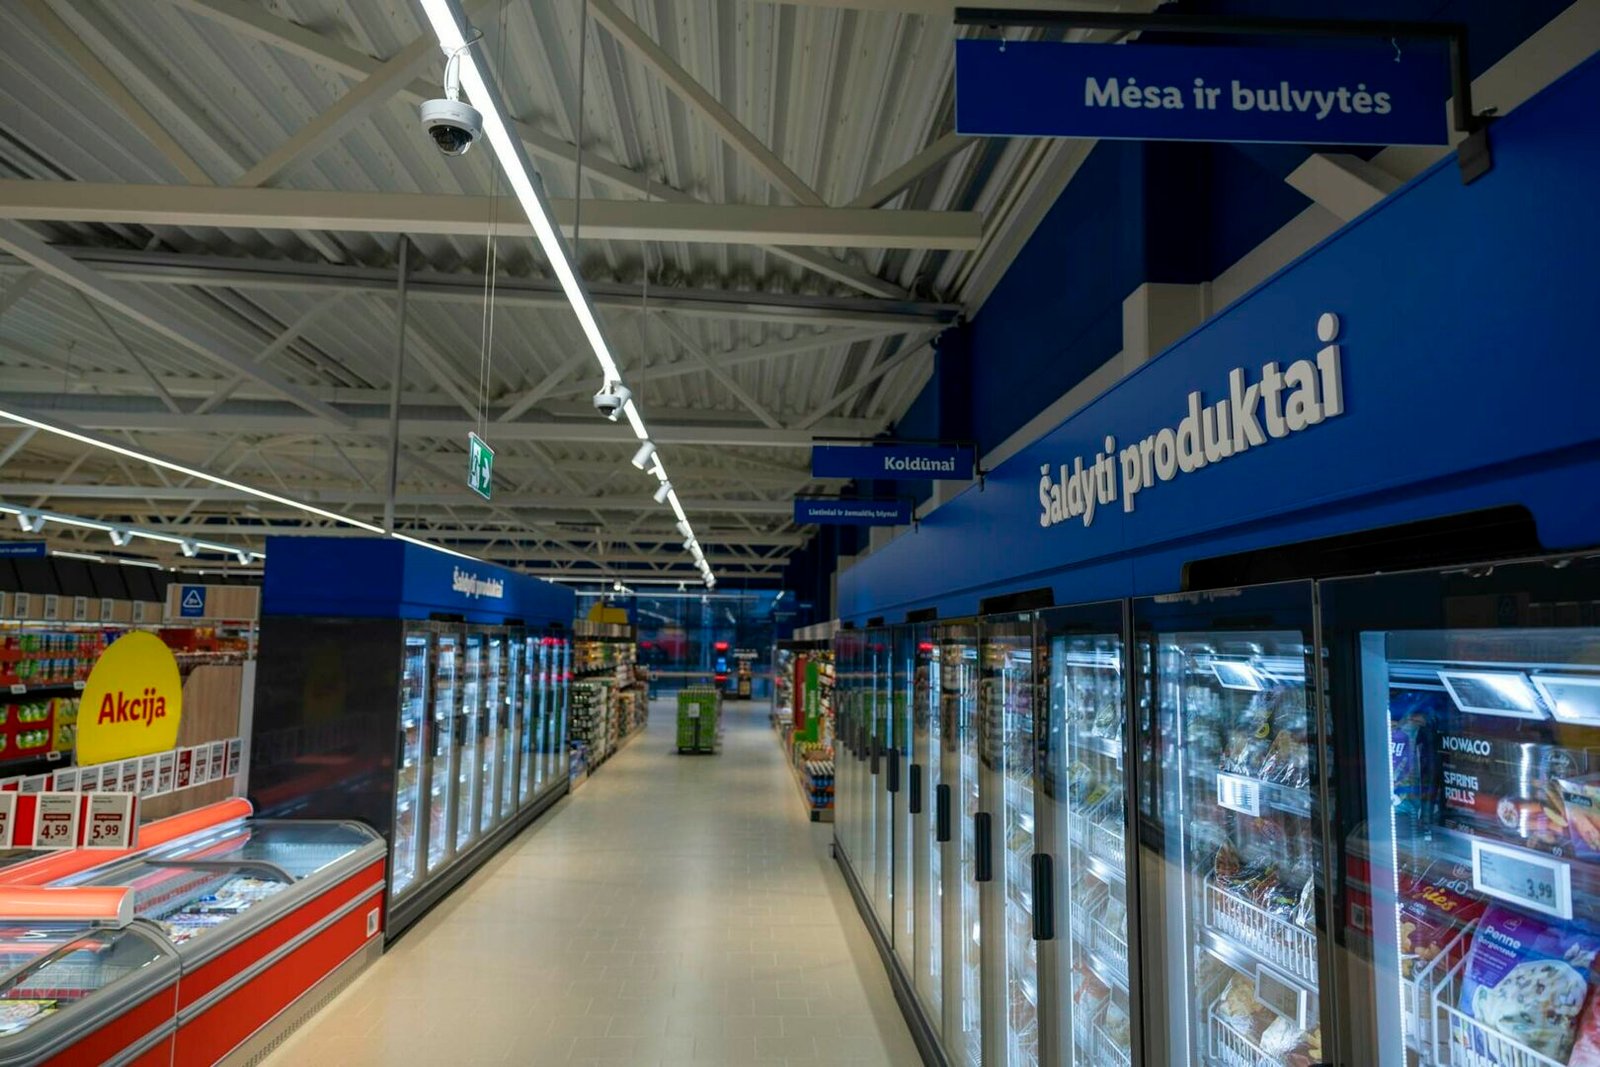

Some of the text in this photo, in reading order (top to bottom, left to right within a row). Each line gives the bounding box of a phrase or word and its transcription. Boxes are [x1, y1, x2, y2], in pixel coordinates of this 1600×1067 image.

[1085, 77, 1392, 120] Mėsa ir bulvytės
[1039, 312, 1345, 527] Šaldyti produktai
[884, 456, 955, 472] Koldūnai
[97, 687, 166, 728] Akcija
[1442, 736, 1491, 756] NOWACO
[1443, 771, 1478, 791] SPRING
[1445, 787, 1475, 805] ROLLS
[41, 824, 69, 839] 4.59
[92, 824, 119, 839] 5.99
[1484, 924, 1522, 950] Penne
